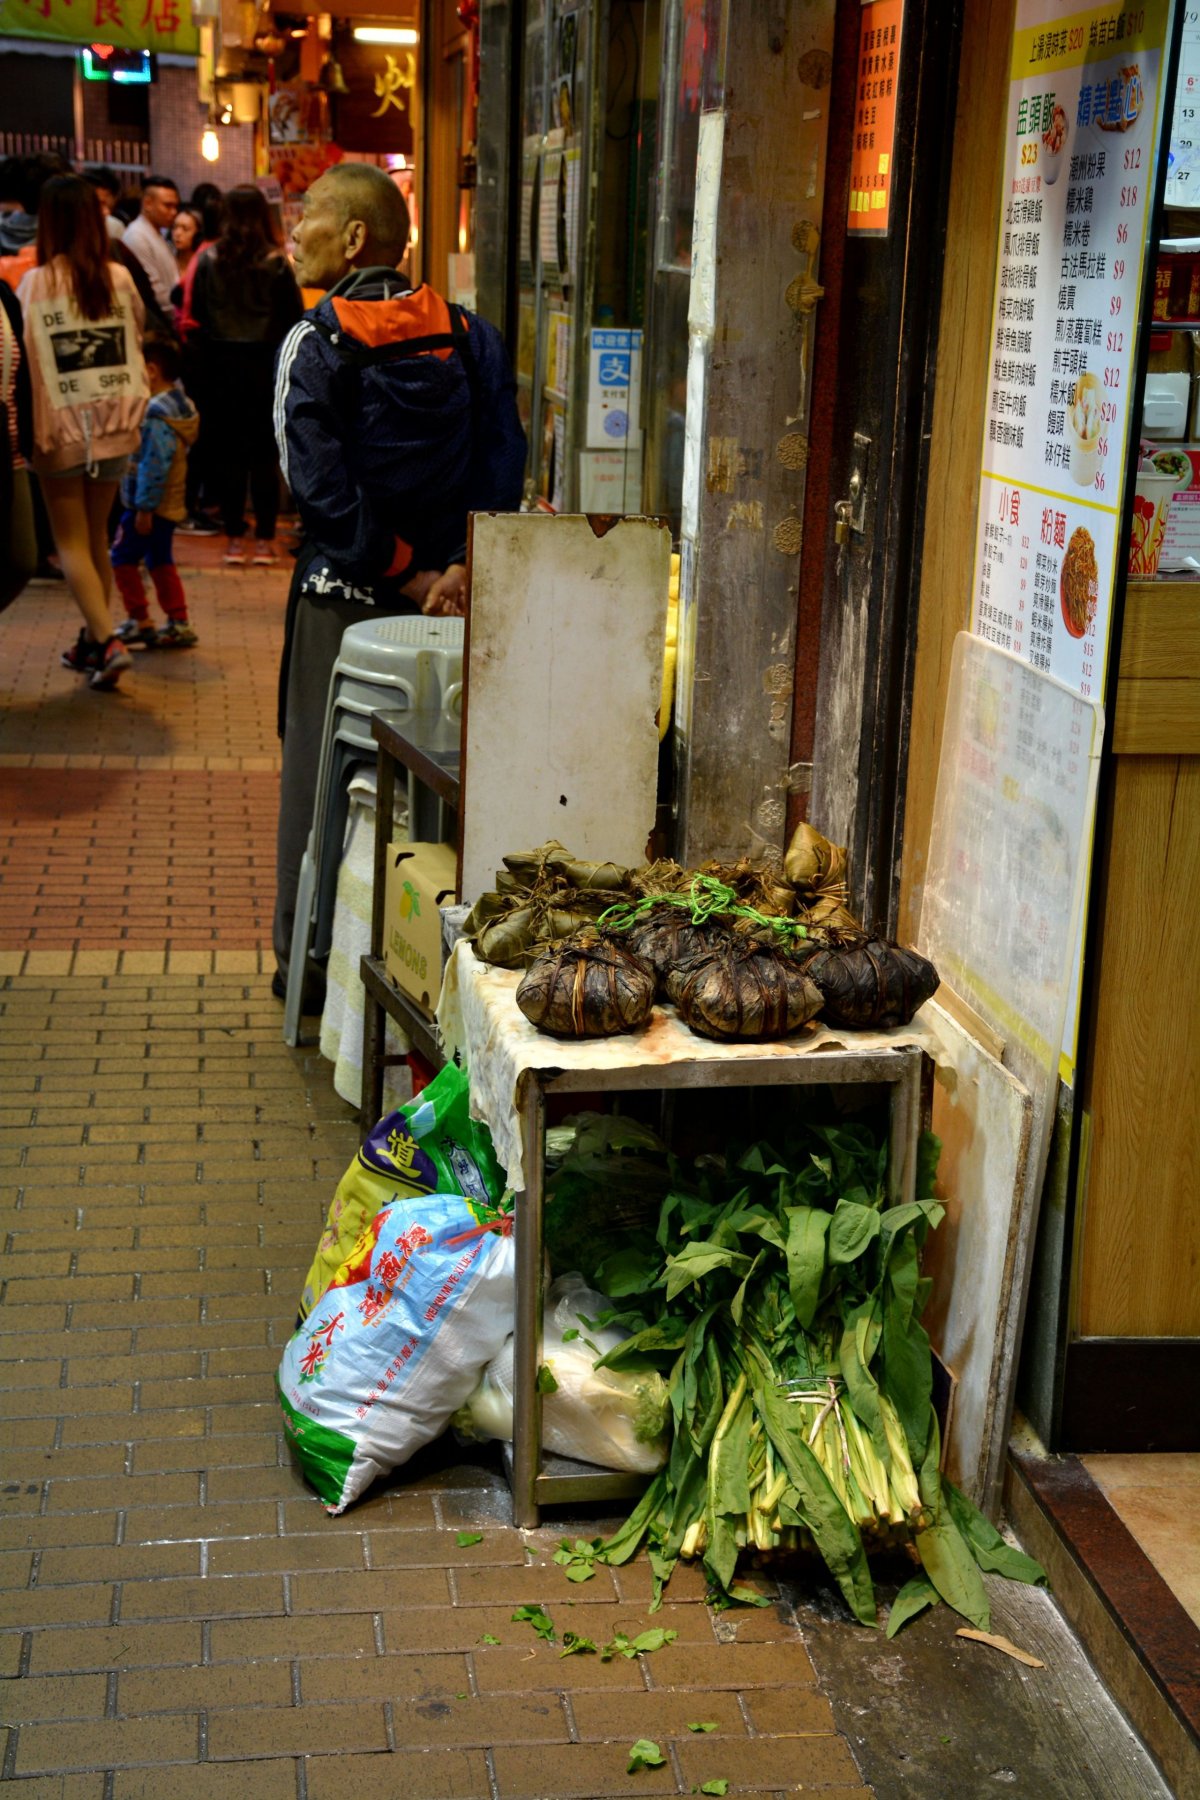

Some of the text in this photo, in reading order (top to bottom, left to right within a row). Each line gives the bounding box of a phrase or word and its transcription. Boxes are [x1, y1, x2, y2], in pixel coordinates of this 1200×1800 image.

[1068, 26, 1084, 51] $20
[1126, 10, 1145, 37] $10
[1187, 77, 1194, 86] 6
[1077, 76, 1142, 127] 精美點心
[1182, 108, 1195, 119] 13
[1021, 143, 1038, 166] $23
[1123, 147, 1141, 170] $12
[1177, 171, 1190, 181] 27
[1120, 186, 1138, 208] $18
[1116, 223, 1128, 244] $6
[1060, 251, 1125, 280] 古法馬拉糕 $9
[1057, 284, 1121, 316] 燒賣 $9
[43, 312, 65, 327] DE
[1106, 331, 1123, 352] $12
[58, 379, 80, 394] DE
[1103, 367, 1120, 388] $12
[1100, 402, 1116, 423] $20
[1097, 436, 1108, 456] $6
[1094, 471, 1105, 491] $6
[998, 486, 1020, 527] 小食
[1083, 641, 1095, 657] $15
[1081, 661, 1092, 678] $12
[1080, 681, 1091, 697] $19
[424, 1305, 439, 1322] WEI
[441, 1283, 453, 1296] MI
[447, 1274, 460, 1286] YE
[299, 1311, 345, 1376] 大米
